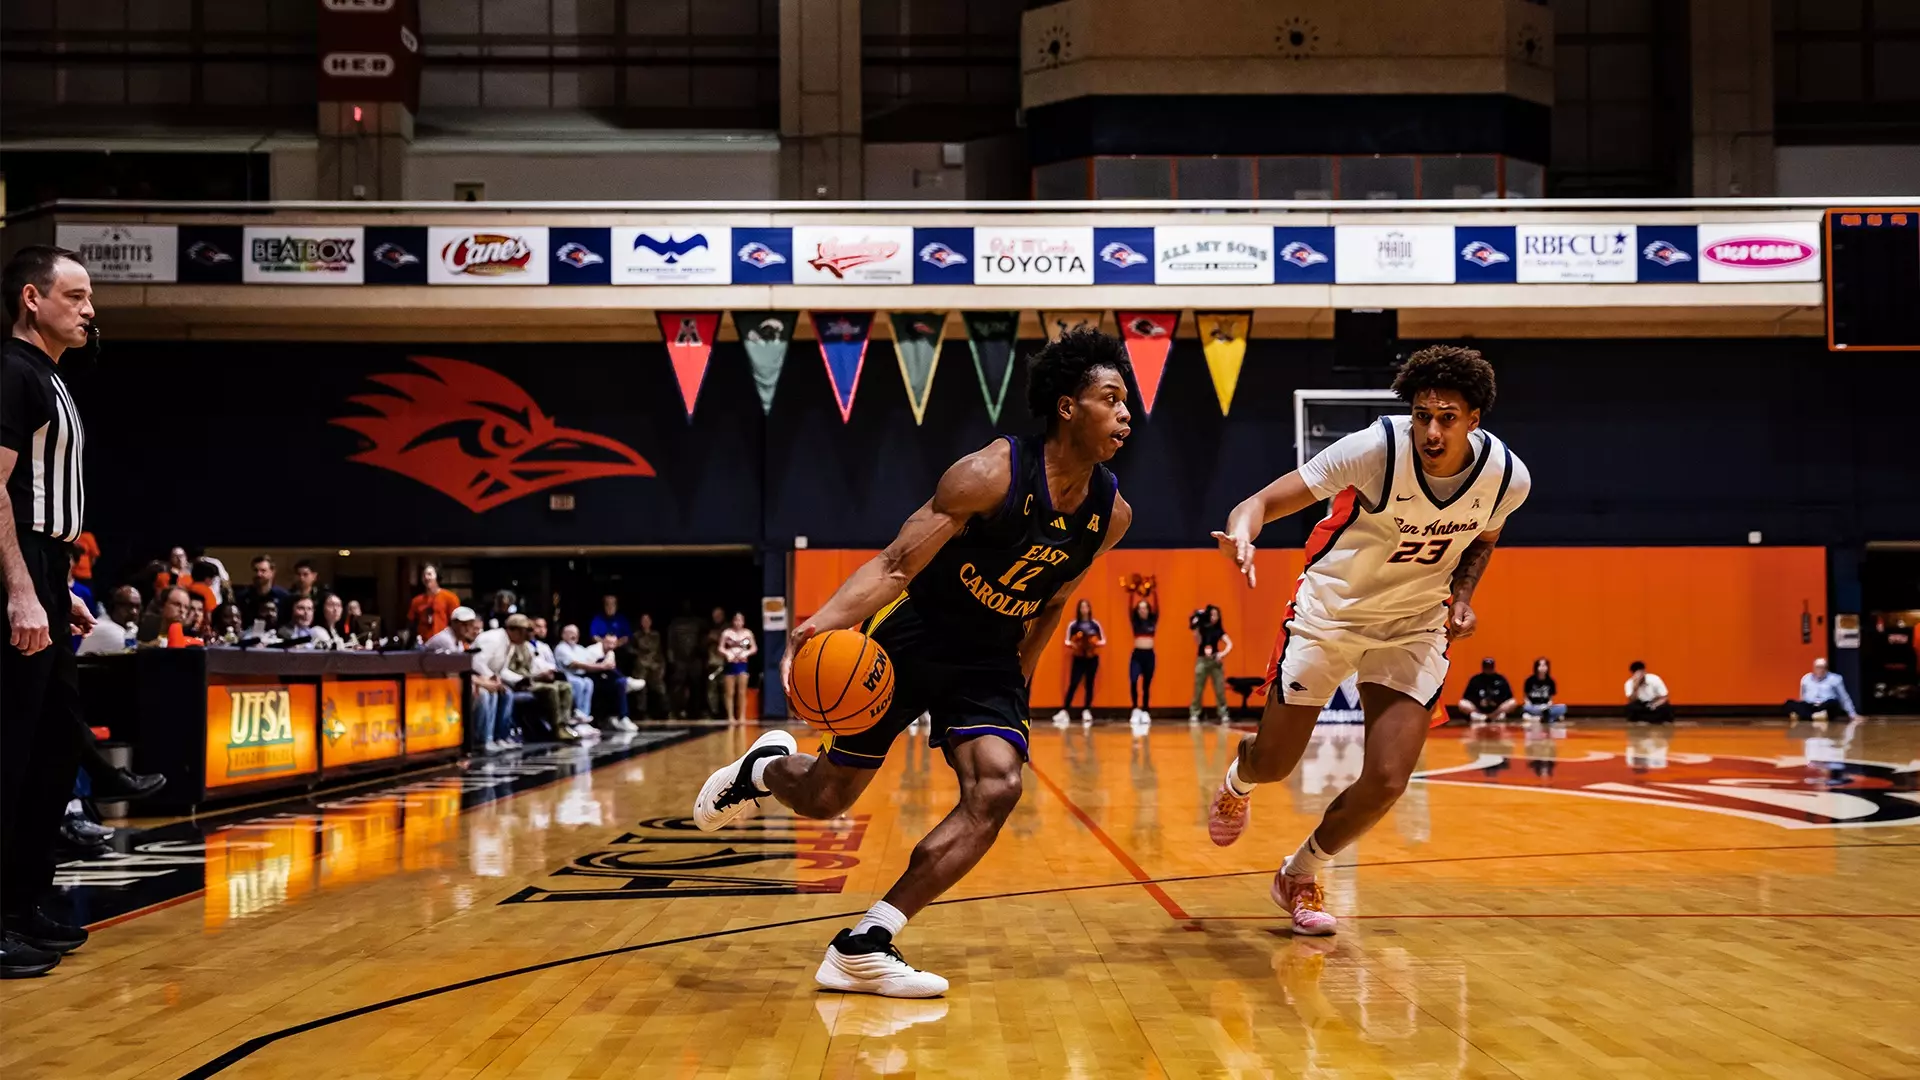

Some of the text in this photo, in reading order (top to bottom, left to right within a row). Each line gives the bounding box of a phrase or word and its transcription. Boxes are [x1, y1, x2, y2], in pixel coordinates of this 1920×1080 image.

[252, 237, 355, 263] BEATBOX
[1161, 240, 1267, 262] ALL MY SONS
[1524, 234, 1609, 256] RBFCU
[982, 255, 1085, 273] TOYOTA
[1023, 494, 1034, 516] C
[1086, 513, 1100, 533] A
[1394, 517, 1420, 535] San
[1021, 545, 1070, 566] EAST
[1387, 538, 1454, 565] 23
[998, 560, 1044, 592] 12
[862, 647, 888, 693] NCAA
[230, 690, 293, 745] UTSA
